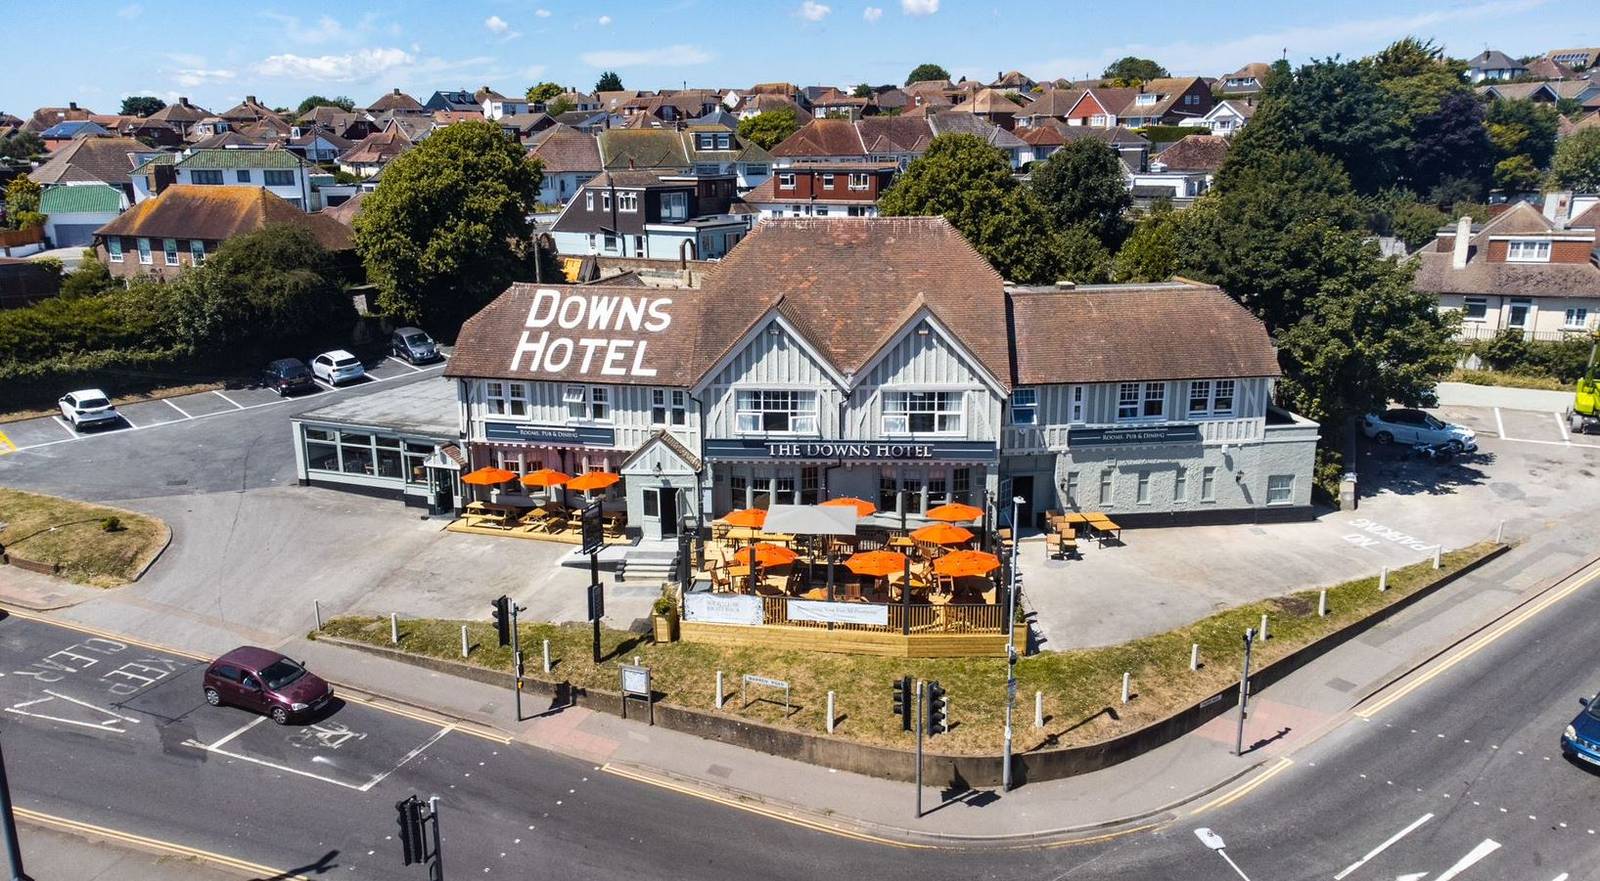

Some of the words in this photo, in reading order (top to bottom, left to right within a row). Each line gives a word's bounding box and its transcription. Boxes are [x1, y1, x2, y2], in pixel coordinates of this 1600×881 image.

[525, 289, 672, 332] DOWNS
[510, 331, 657, 376] HOTEL
[769, 444, 801, 456] THE
[807, 444, 871, 457] DOWNS
[876, 444, 932, 457] HOTEL
[1343, 534, 1381, 552] NO
[1349, 518, 1440, 551] PARKING
[13, 638, 128, 682] CLEAR
[99, 655, 187, 695] KEEP
